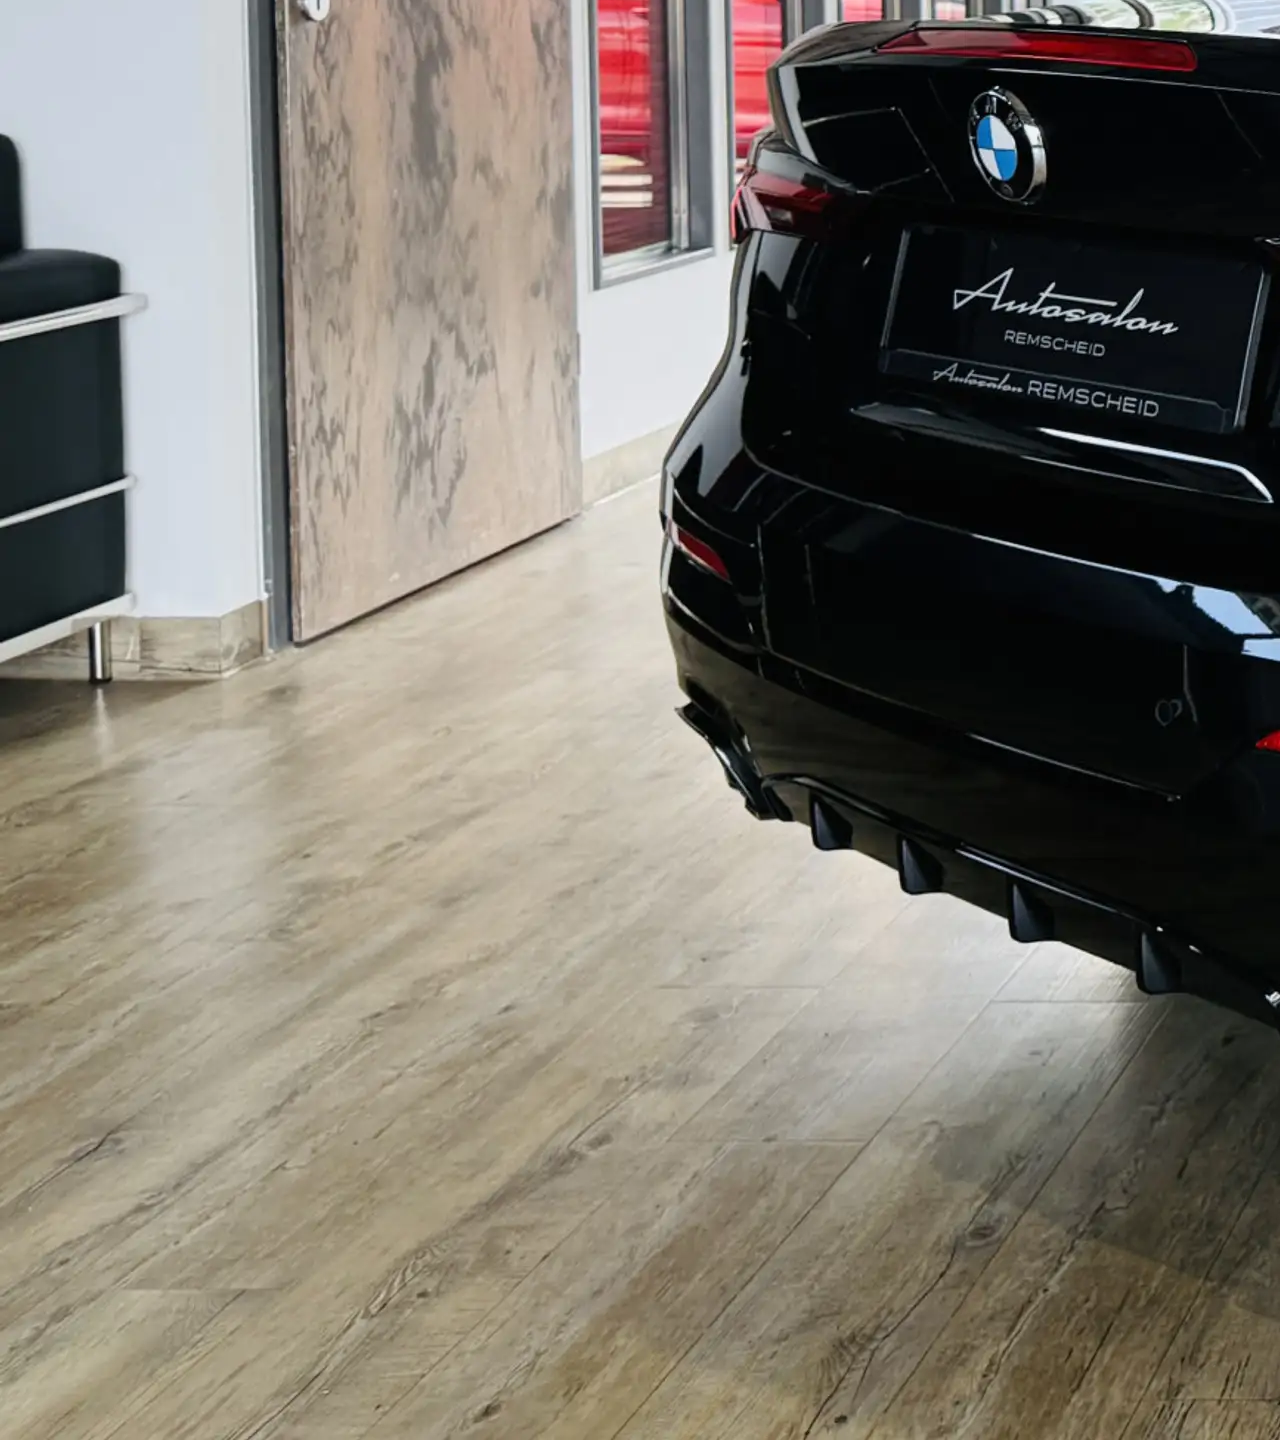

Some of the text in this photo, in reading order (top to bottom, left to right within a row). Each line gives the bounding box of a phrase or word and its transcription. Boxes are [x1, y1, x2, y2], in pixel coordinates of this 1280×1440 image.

[952, 267, 1180, 335] Autosalon
[1004, 329, 1106, 358] REMSCHEID
[933, 362, 1160, 418] Autosalon REMSCHEID
